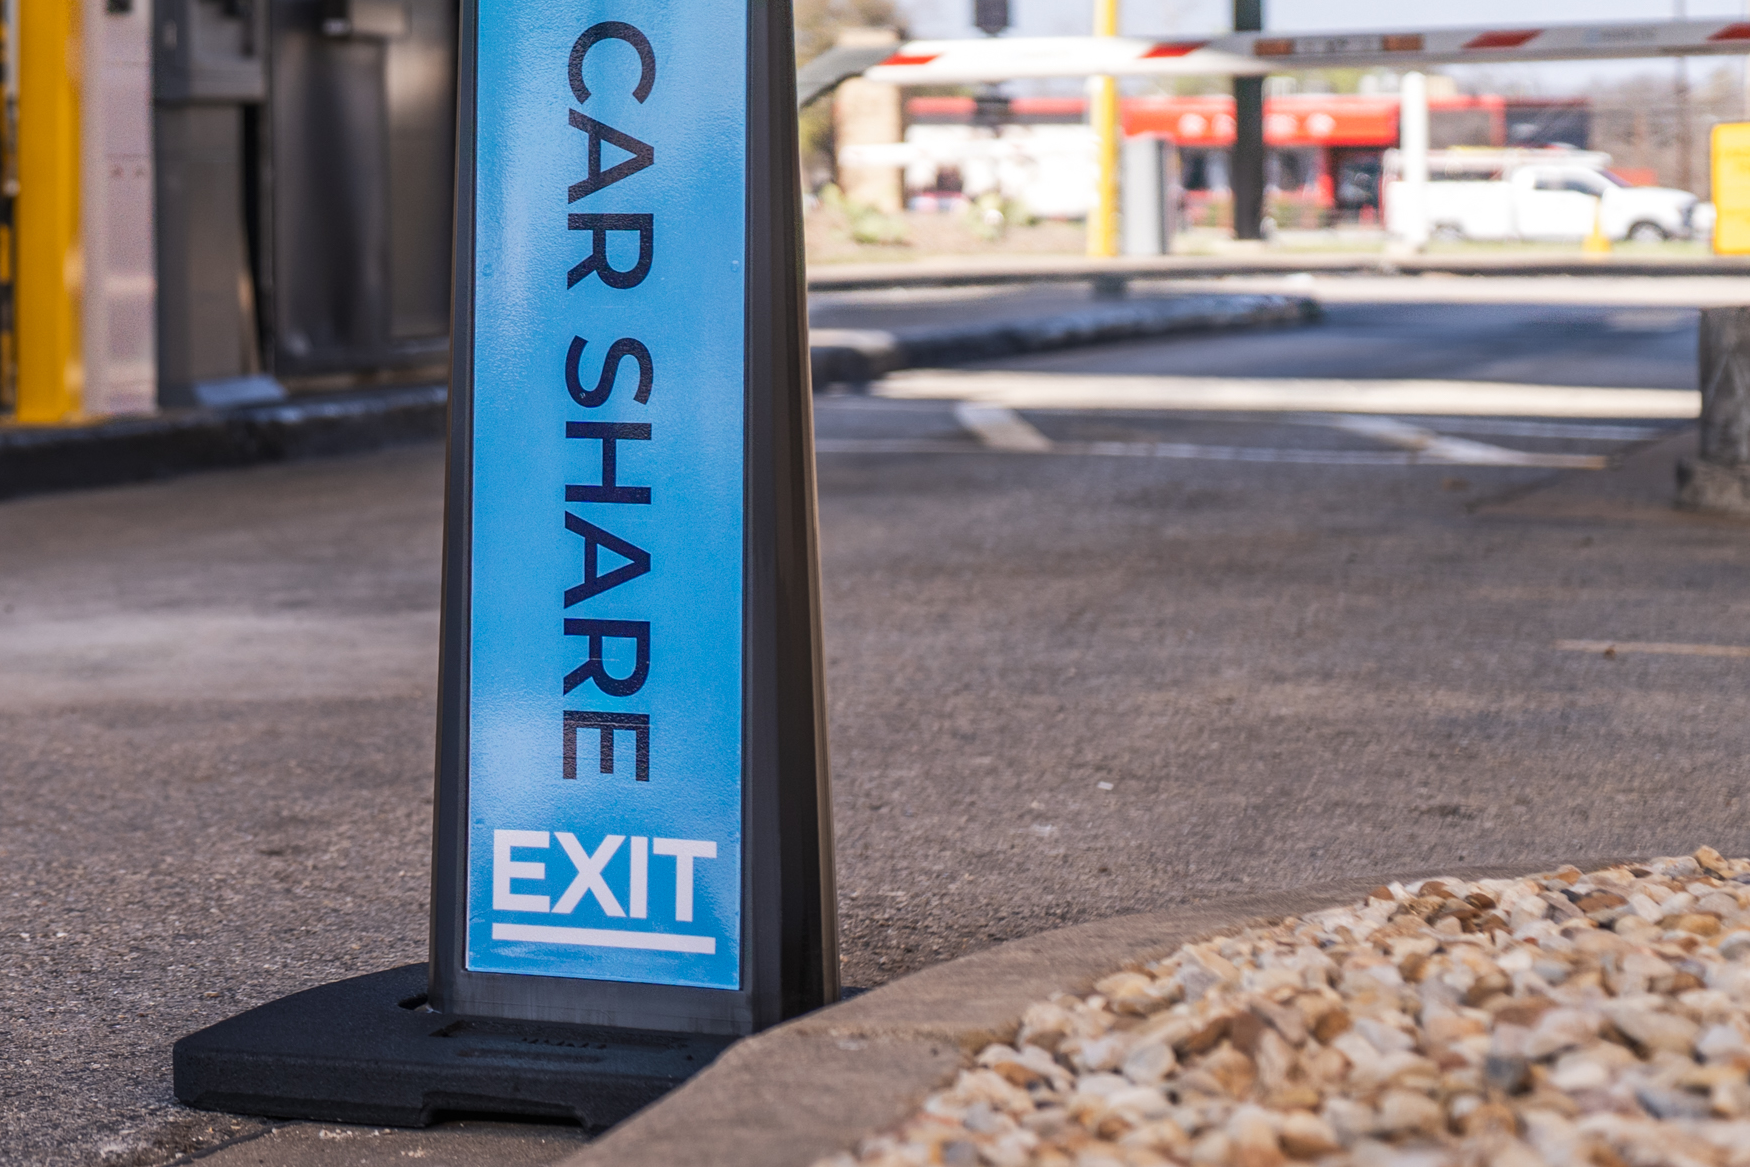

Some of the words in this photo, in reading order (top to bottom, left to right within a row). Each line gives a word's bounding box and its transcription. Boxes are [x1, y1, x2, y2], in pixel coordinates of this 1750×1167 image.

[567, 21, 656, 290] CAR
[562, 335, 654, 782] SHARE
[492, 828, 717, 922] EXIT
